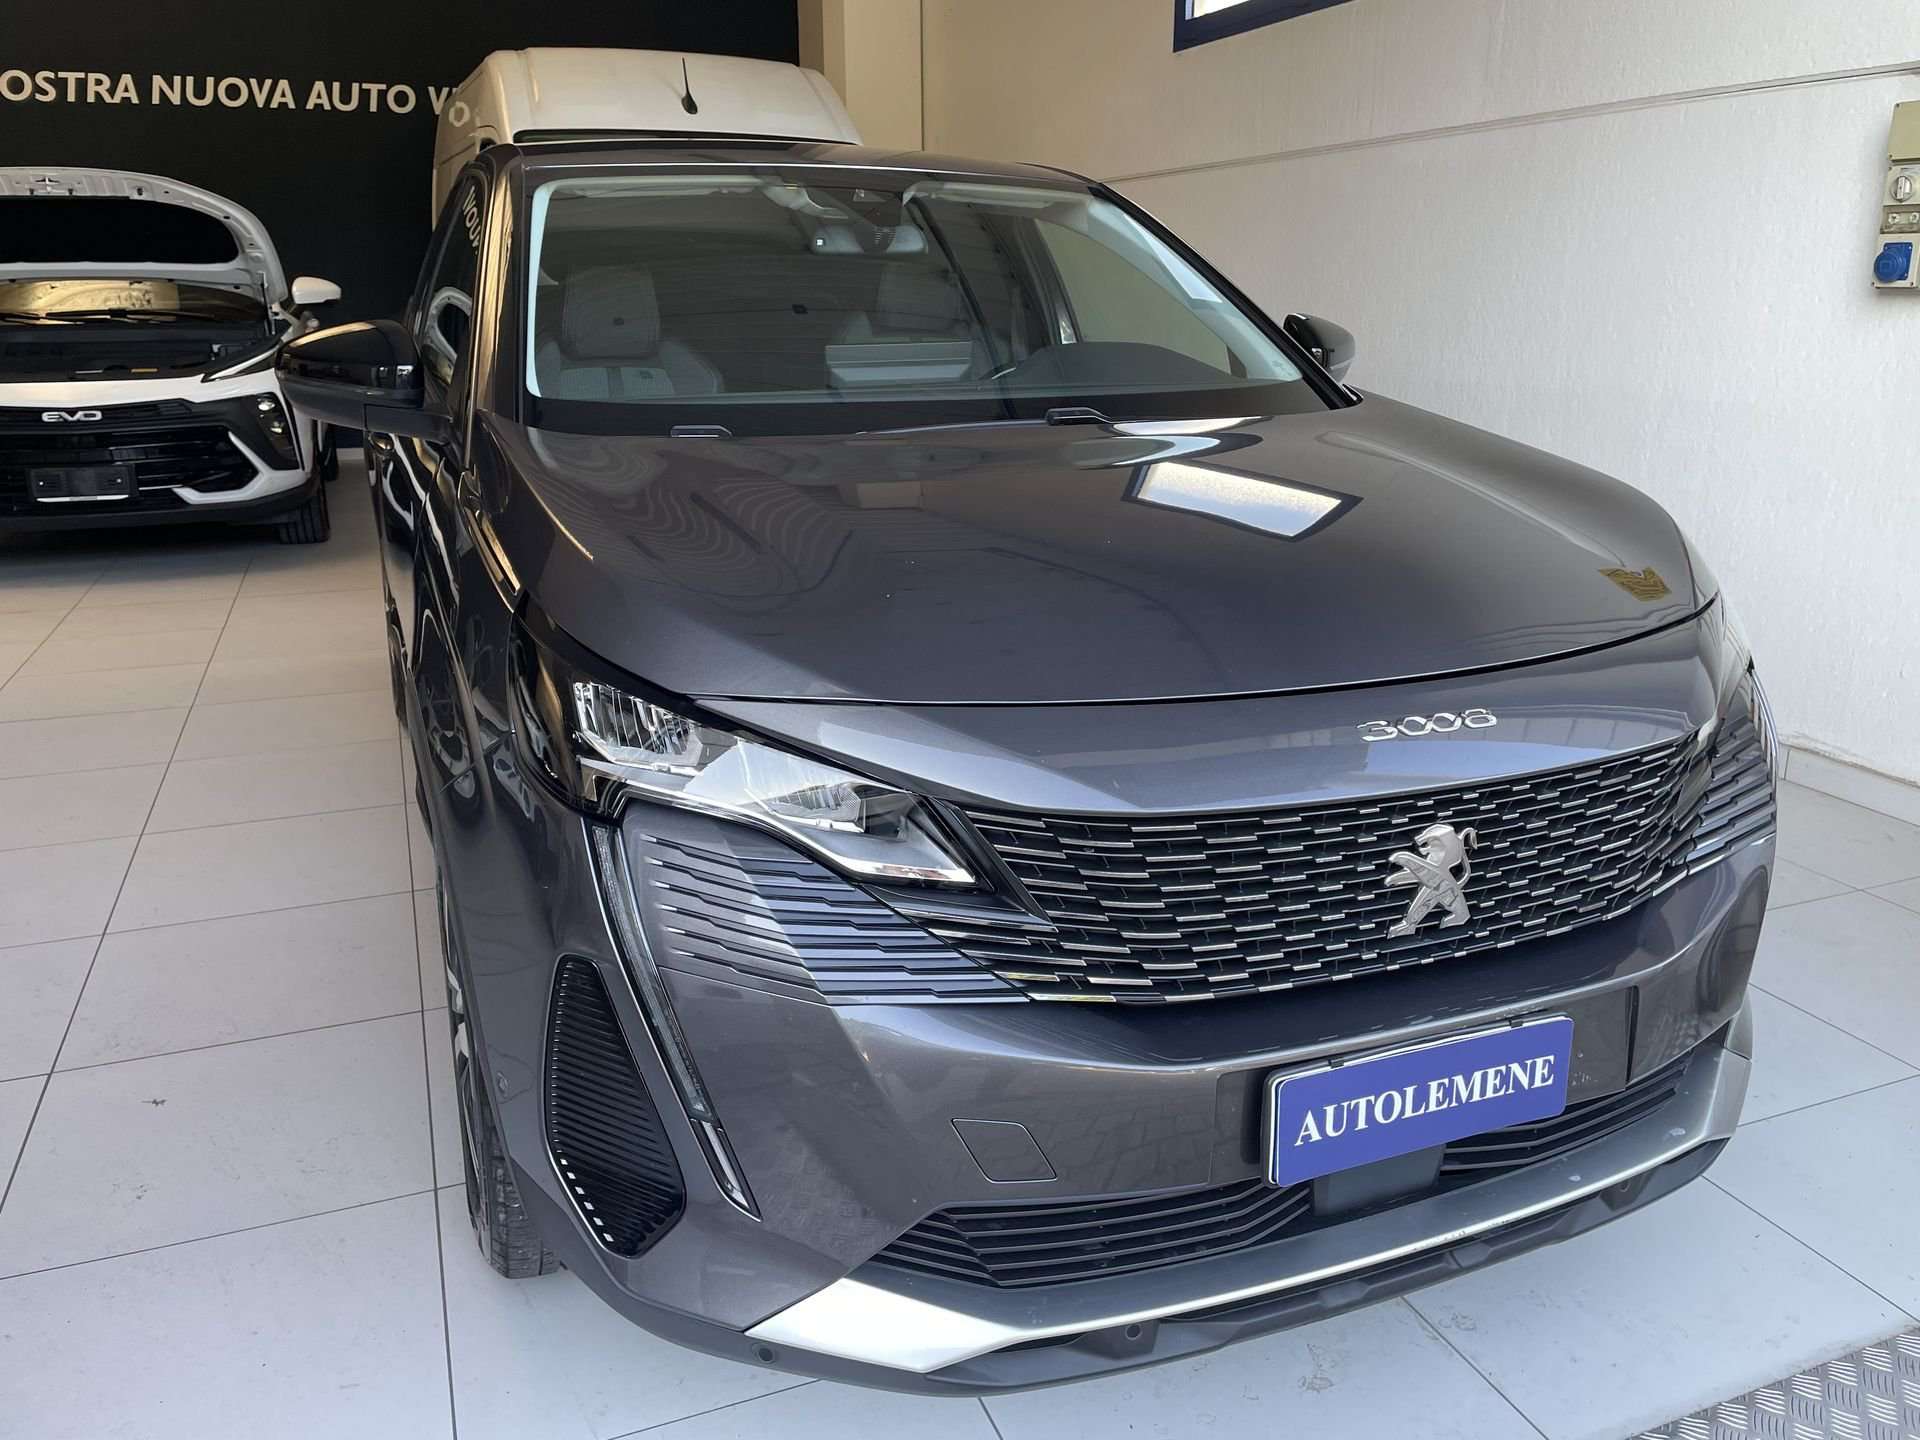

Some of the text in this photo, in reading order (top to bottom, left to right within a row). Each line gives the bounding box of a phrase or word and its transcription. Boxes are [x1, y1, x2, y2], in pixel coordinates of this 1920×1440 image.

[0, 69, 140, 104] OSTRA
[151, 74, 297, 109] NUOVA
[305, 80, 417, 114] AUTO
[41, 410, 102, 422] EVO
[1356, 708, 1497, 742] 3008
[1294, 1054, 1555, 1147] AUTOLEMENE
